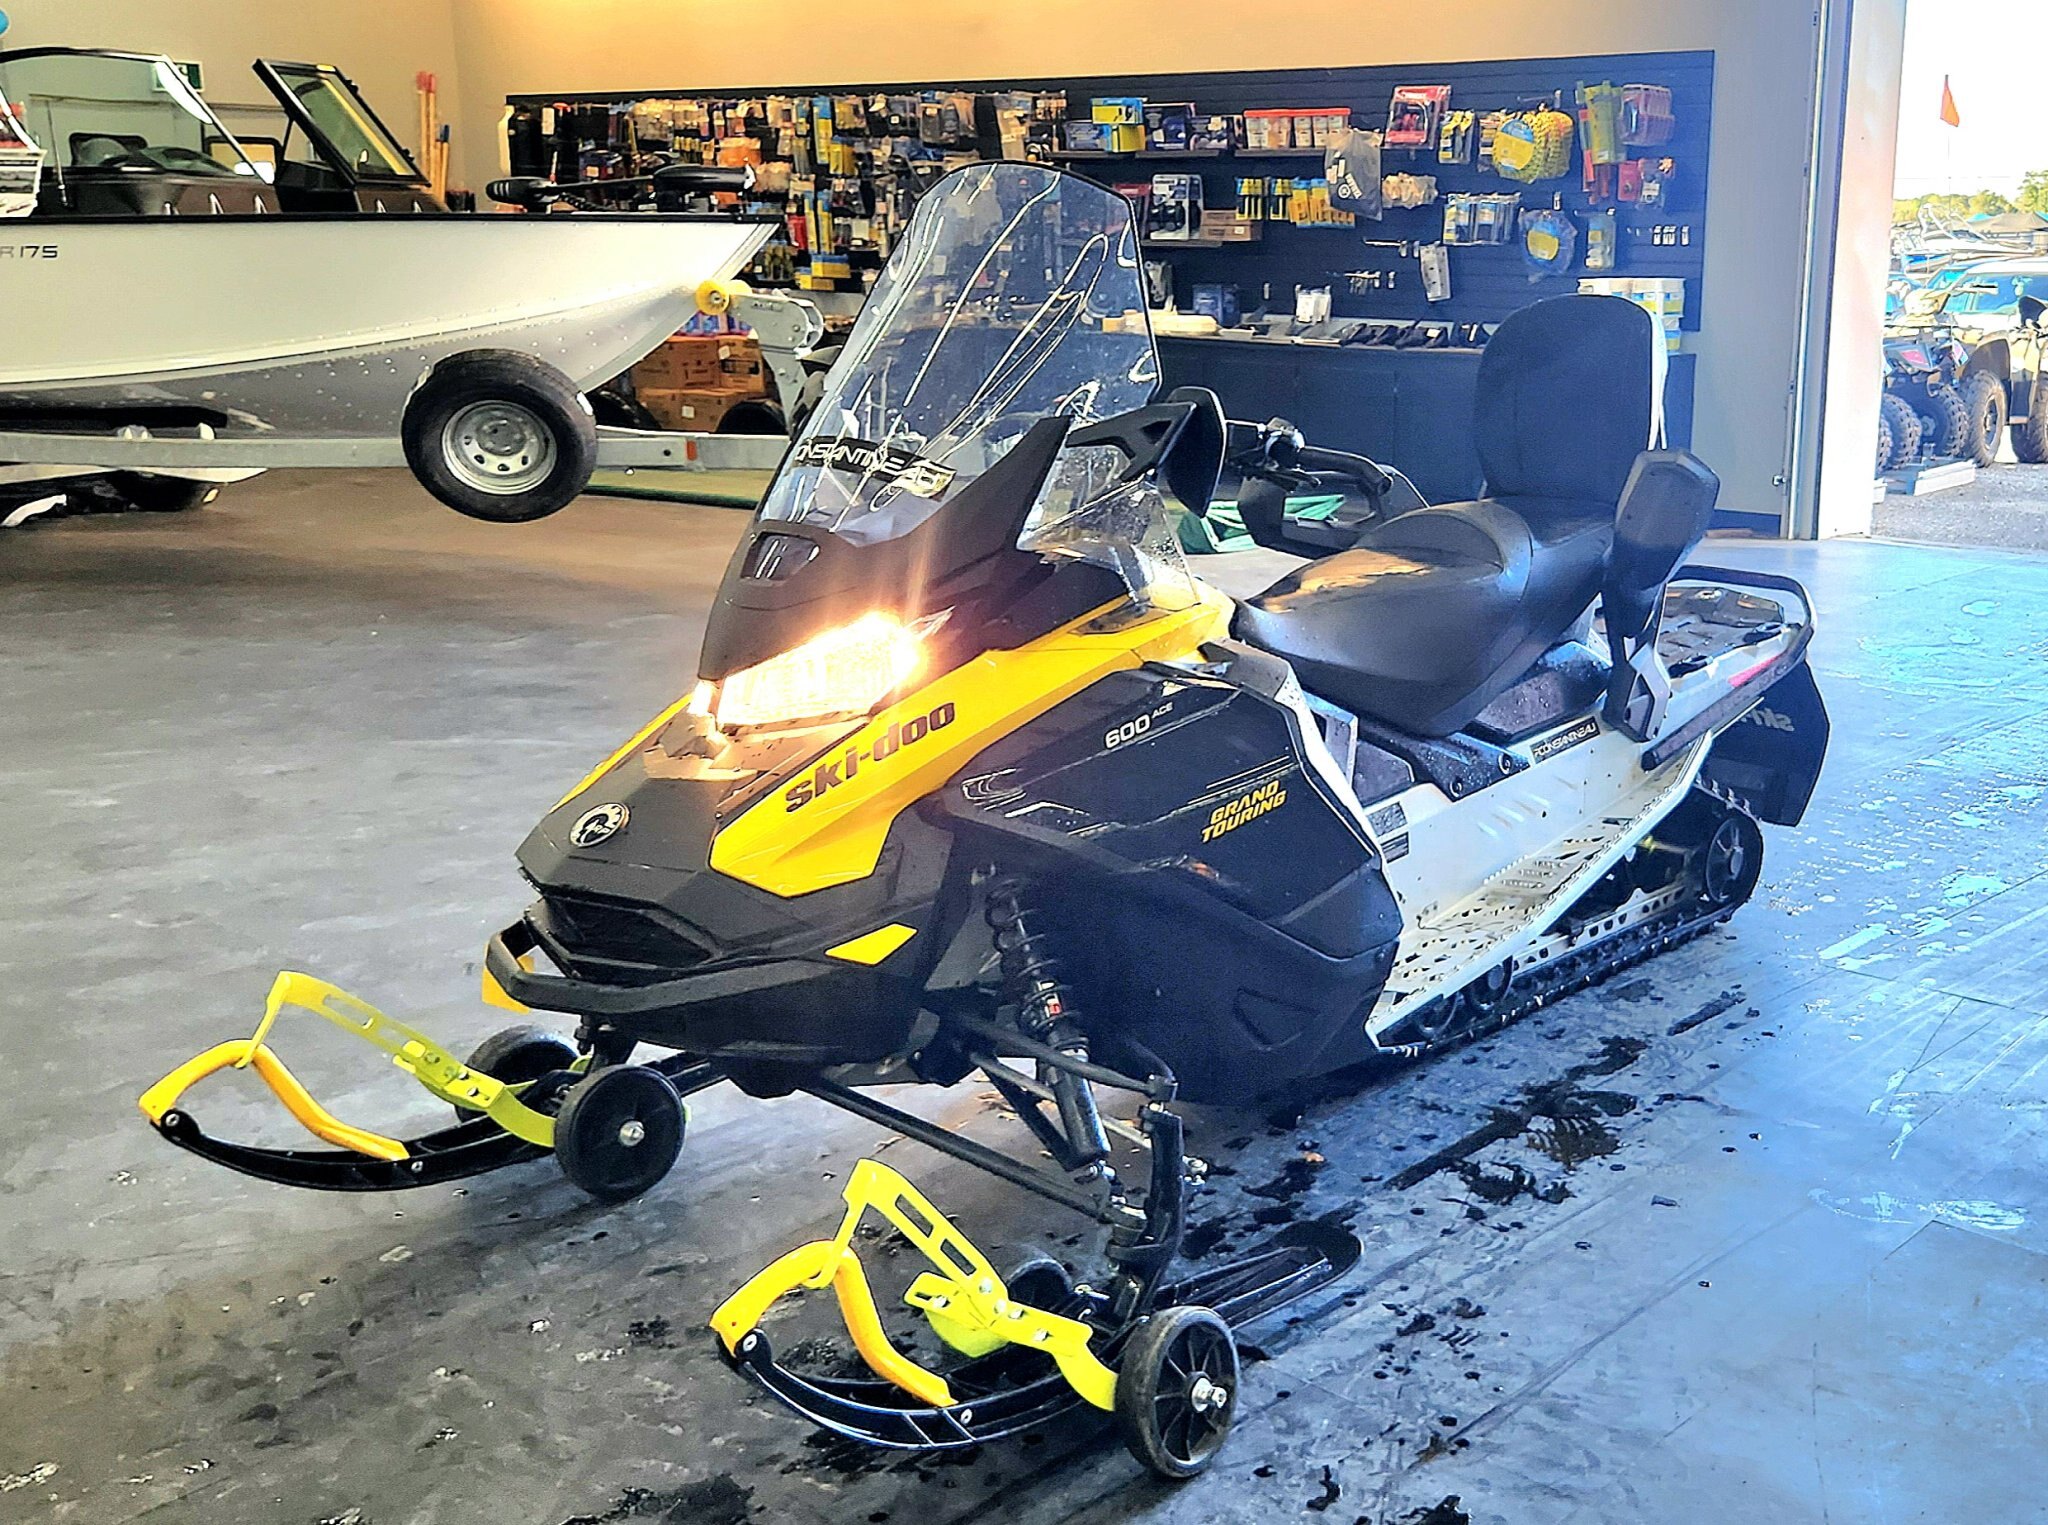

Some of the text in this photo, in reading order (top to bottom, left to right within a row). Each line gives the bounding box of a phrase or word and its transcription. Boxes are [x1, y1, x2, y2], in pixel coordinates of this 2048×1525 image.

[20, 245, 58, 259] 175
[1105, 701, 1174, 749] 600 ACE
[1201, 789, 1287, 844] TOURING
[1210, 779, 1280, 826] GRAND
